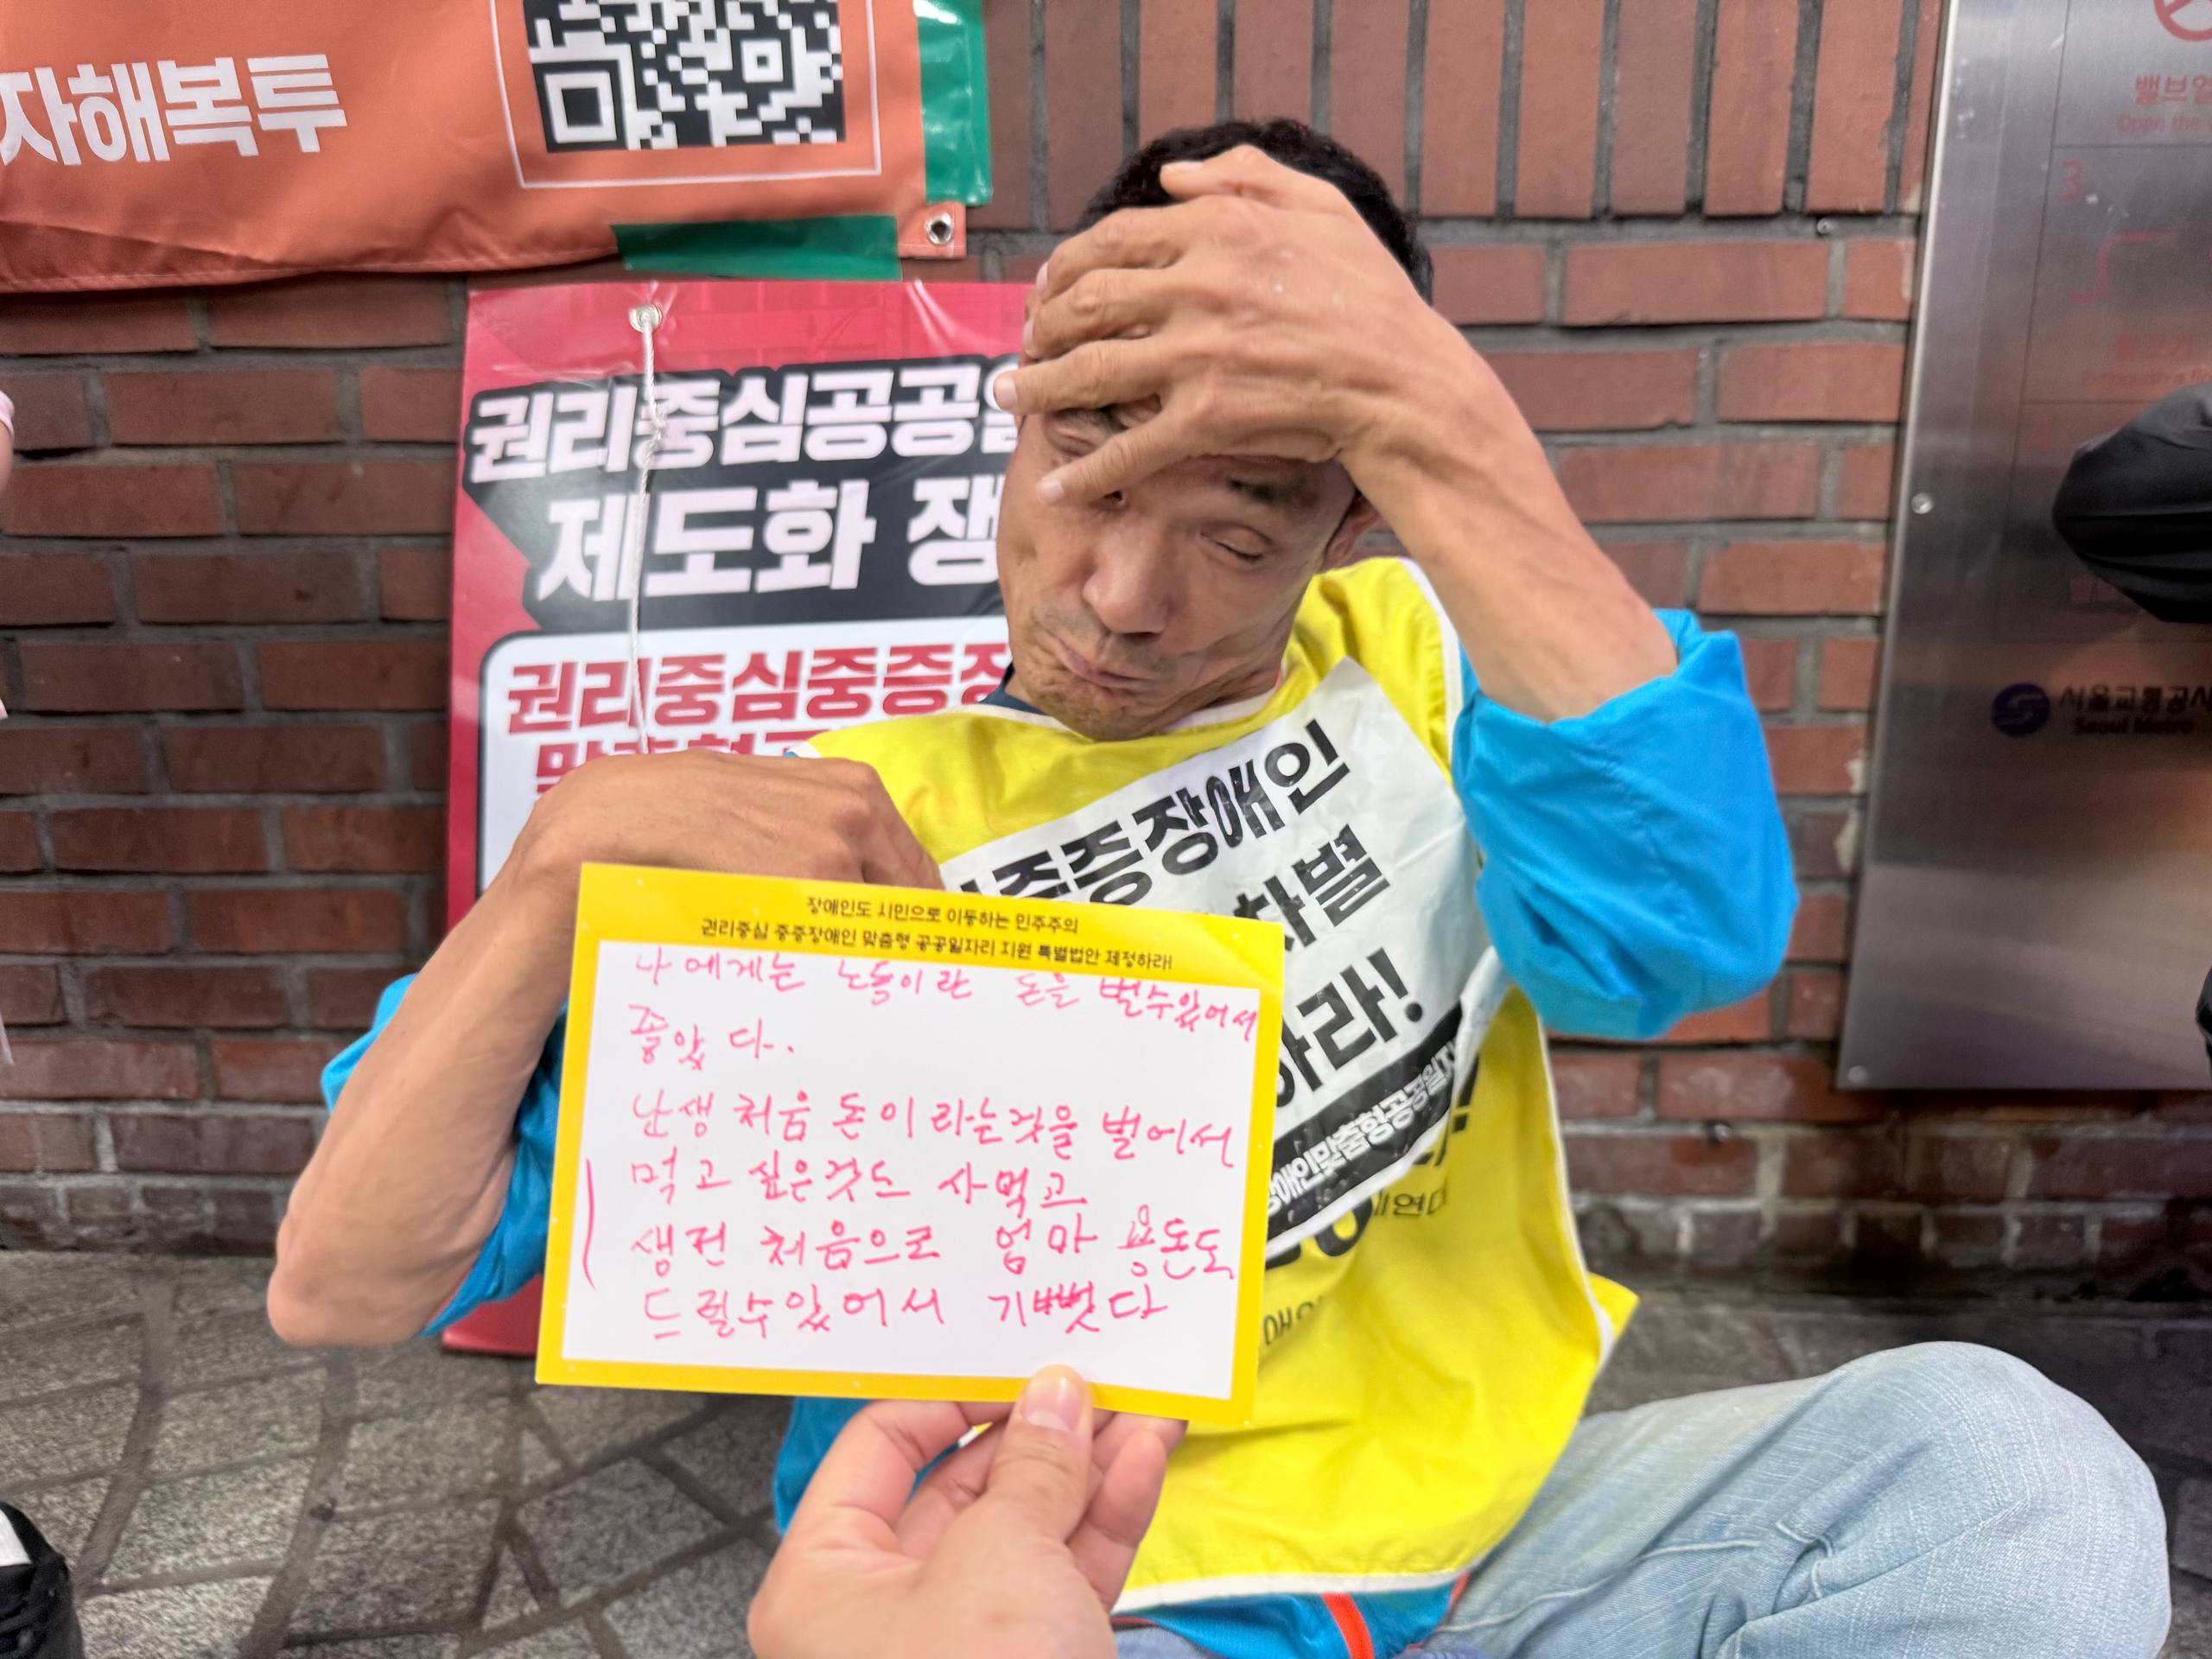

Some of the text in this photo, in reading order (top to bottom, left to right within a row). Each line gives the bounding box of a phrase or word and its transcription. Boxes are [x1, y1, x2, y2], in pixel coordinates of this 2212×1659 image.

[0, 54, 347, 166] 자해복투
[537, 479, 877, 601] 제도화
[701, 918, 1173, 971] 권리중심 중증장애인 맞춤형 공공일자리 지원 특별법안 제정하라!
[808, 896, 1078, 934] 장애인도 시민으로 이동하는 민주주의
